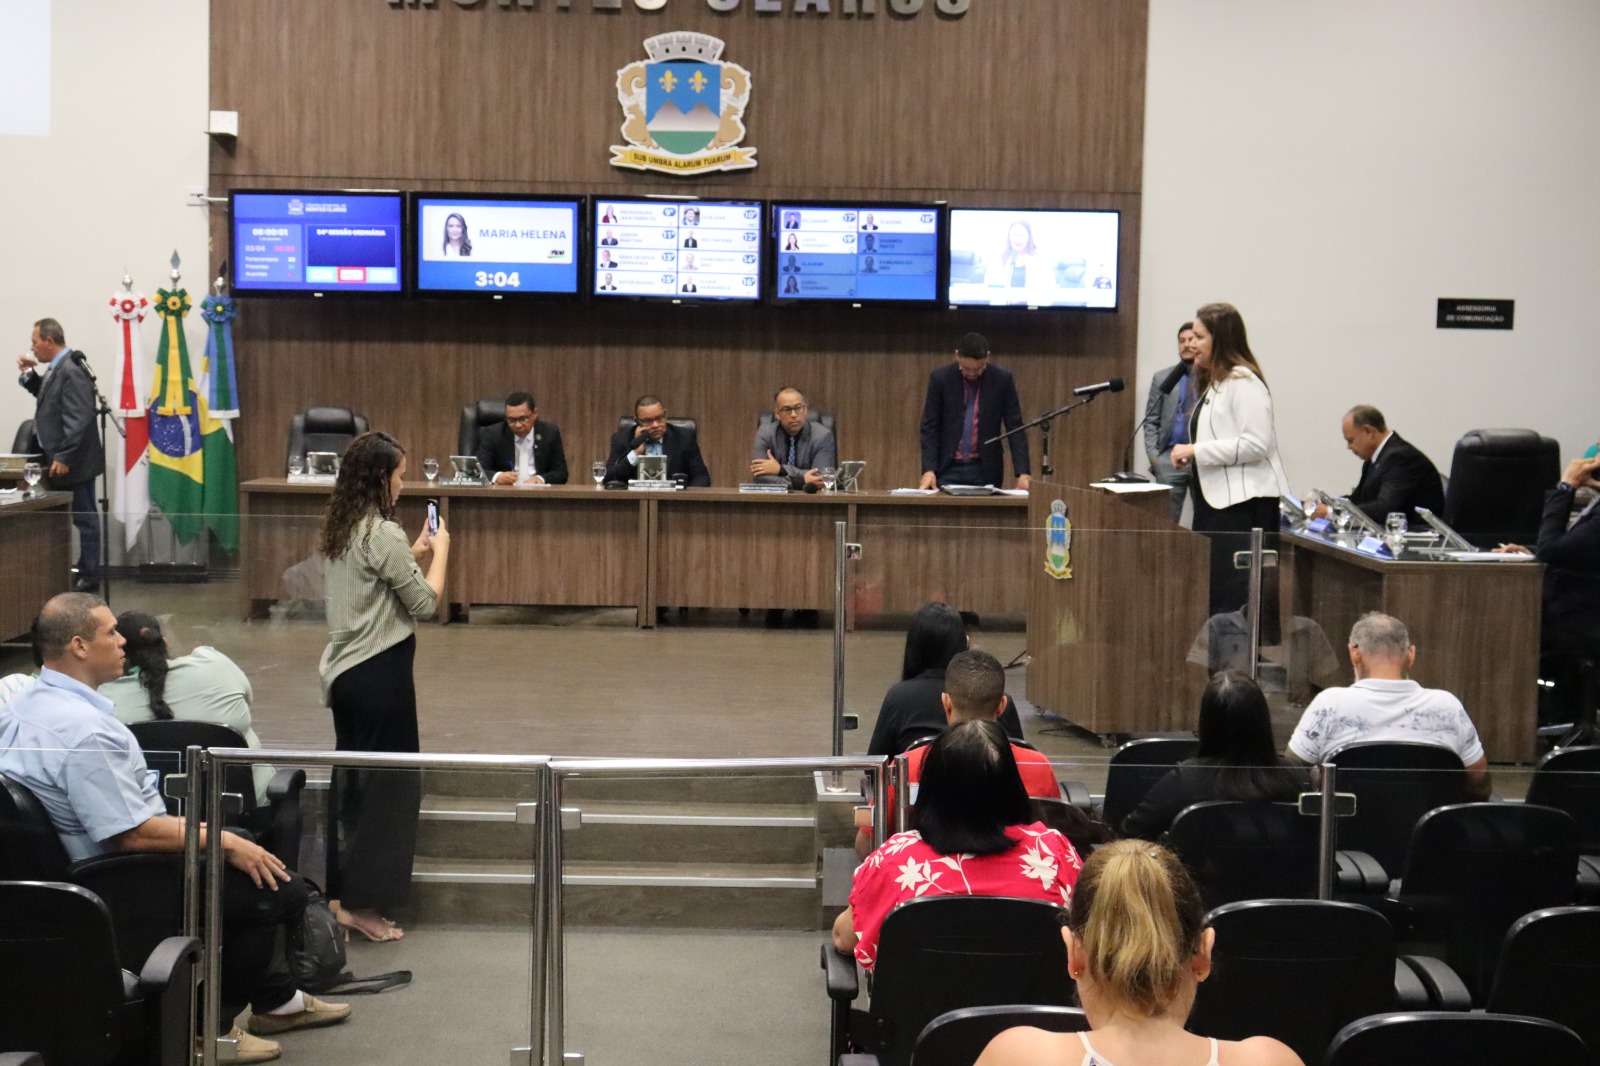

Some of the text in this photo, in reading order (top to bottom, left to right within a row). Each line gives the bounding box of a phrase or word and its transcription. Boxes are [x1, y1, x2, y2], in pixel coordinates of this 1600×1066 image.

[634, 153, 731, 168] SUB UMBRA ALARUM TUARUM
[479, 229, 566, 240] MARIA HELENA
[475, 271, 520, 287] 3:04
